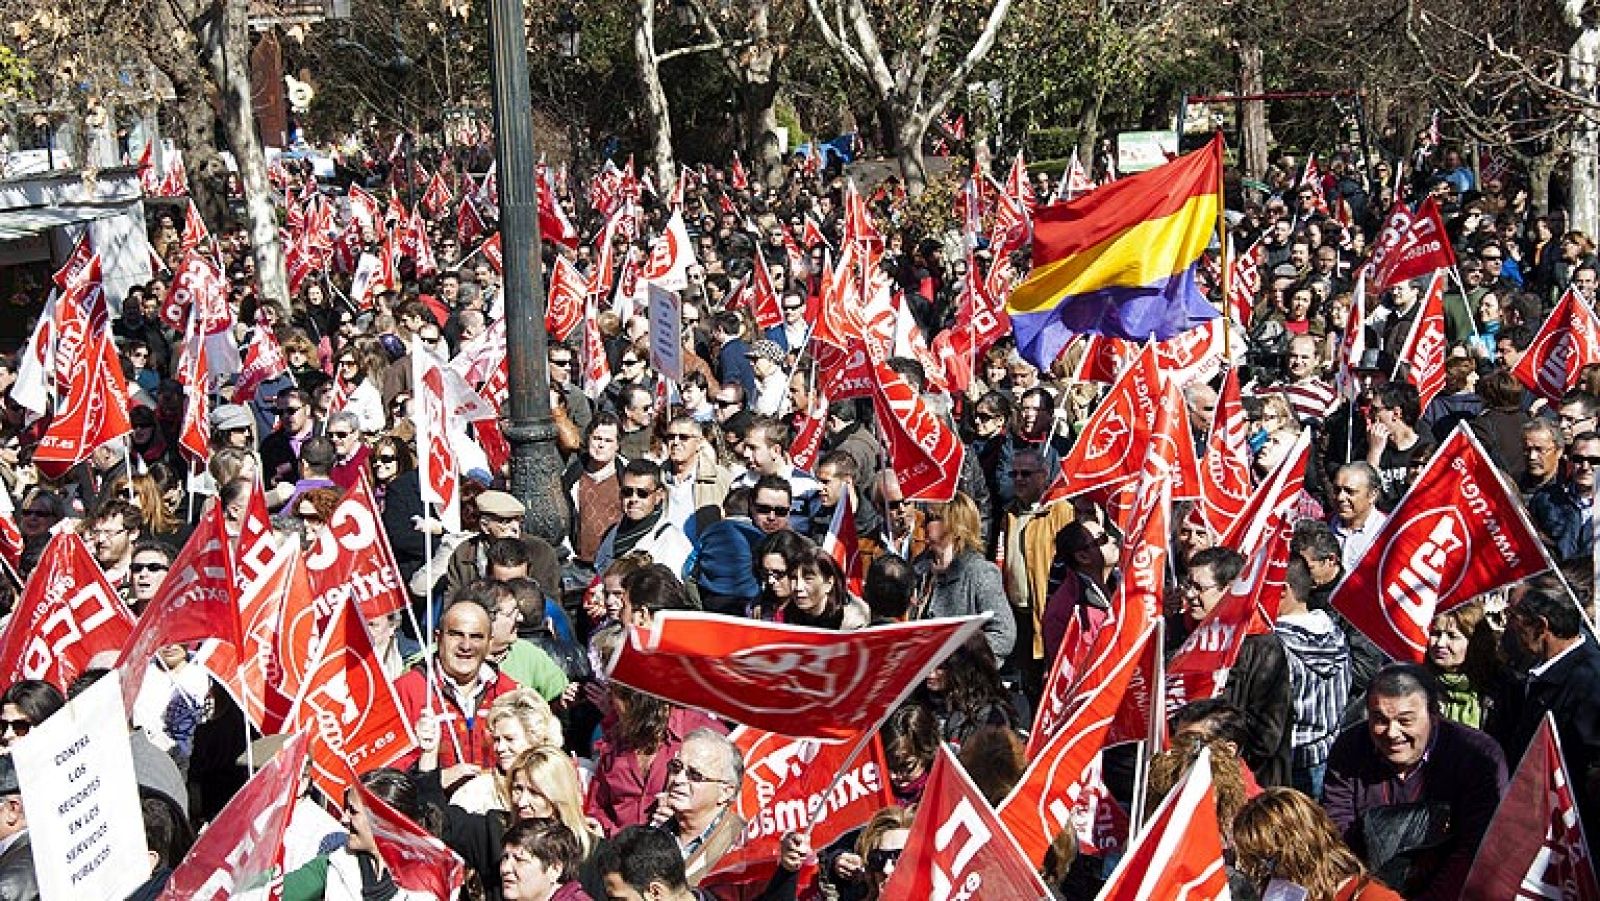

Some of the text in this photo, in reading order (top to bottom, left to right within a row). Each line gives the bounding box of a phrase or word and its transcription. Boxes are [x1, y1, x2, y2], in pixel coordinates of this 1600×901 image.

[1387, 514, 1463, 628] UGT
[54, 734, 90, 766] CONTRA
[68, 763, 87, 783] LOS
[68, 803, 100, 835] EN LOS
